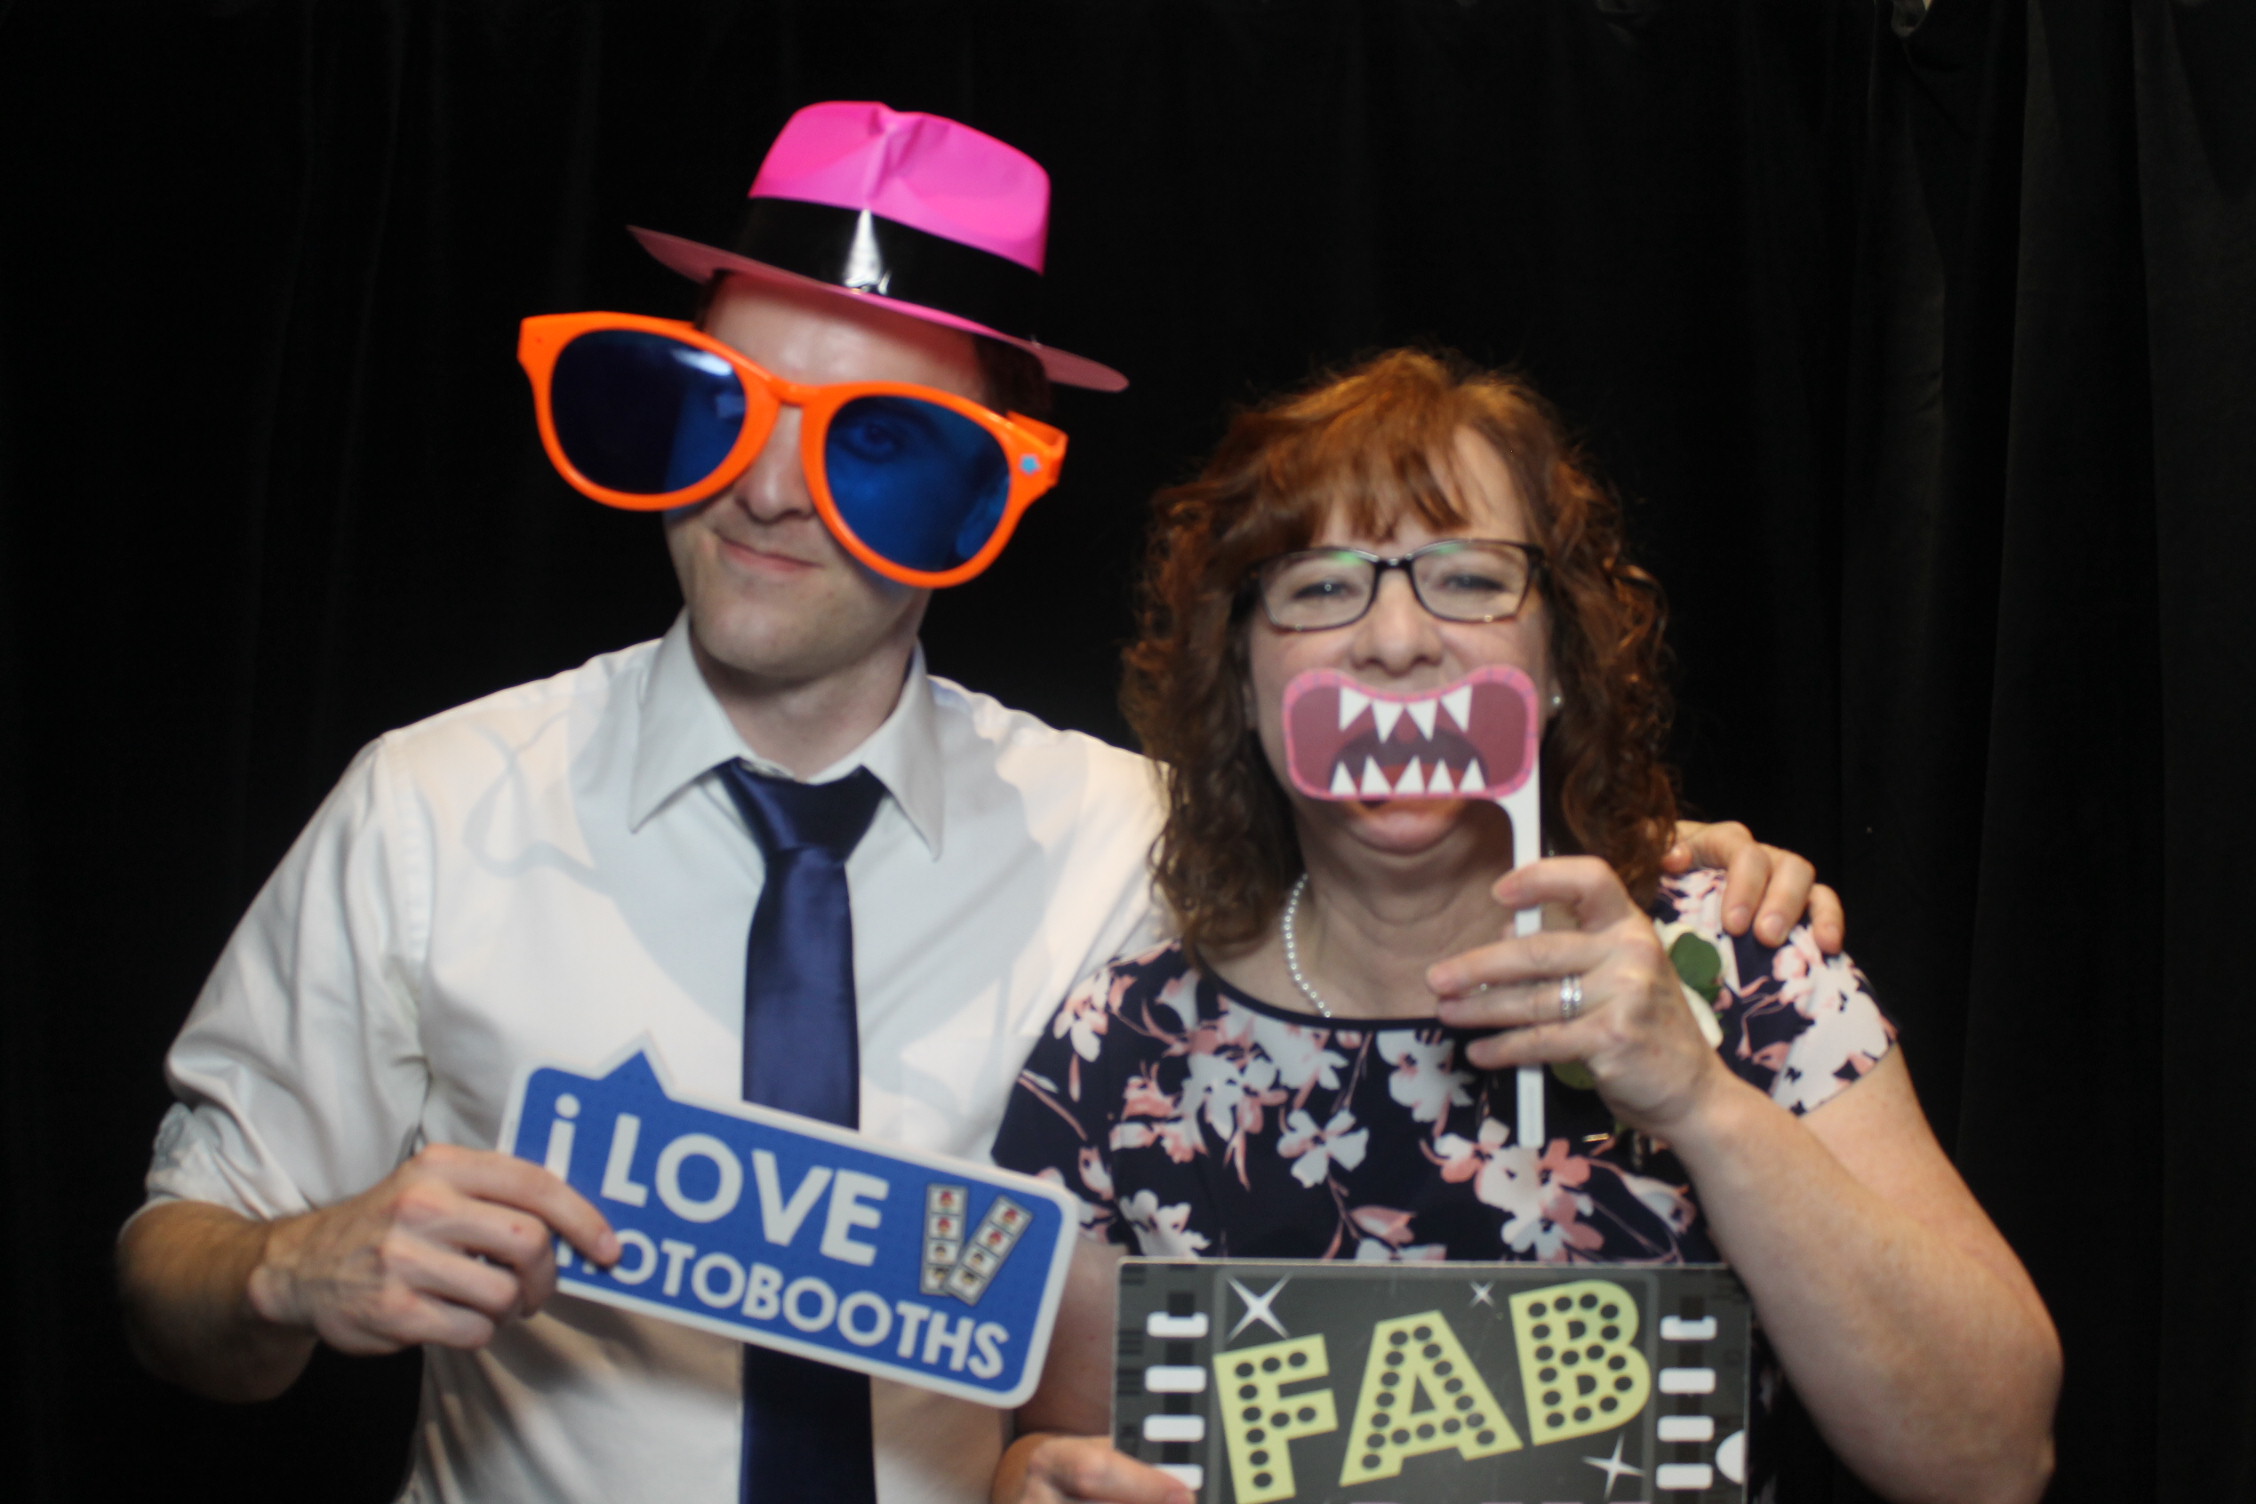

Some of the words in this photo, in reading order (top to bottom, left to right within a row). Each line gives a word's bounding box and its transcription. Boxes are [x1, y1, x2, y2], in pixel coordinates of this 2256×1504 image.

[601, 1112, 890, 1266] LOVE
[556, 1228, 1009, 1380] OTOBOOTHS
[1212, 1279, 1652, 1504] FAB
